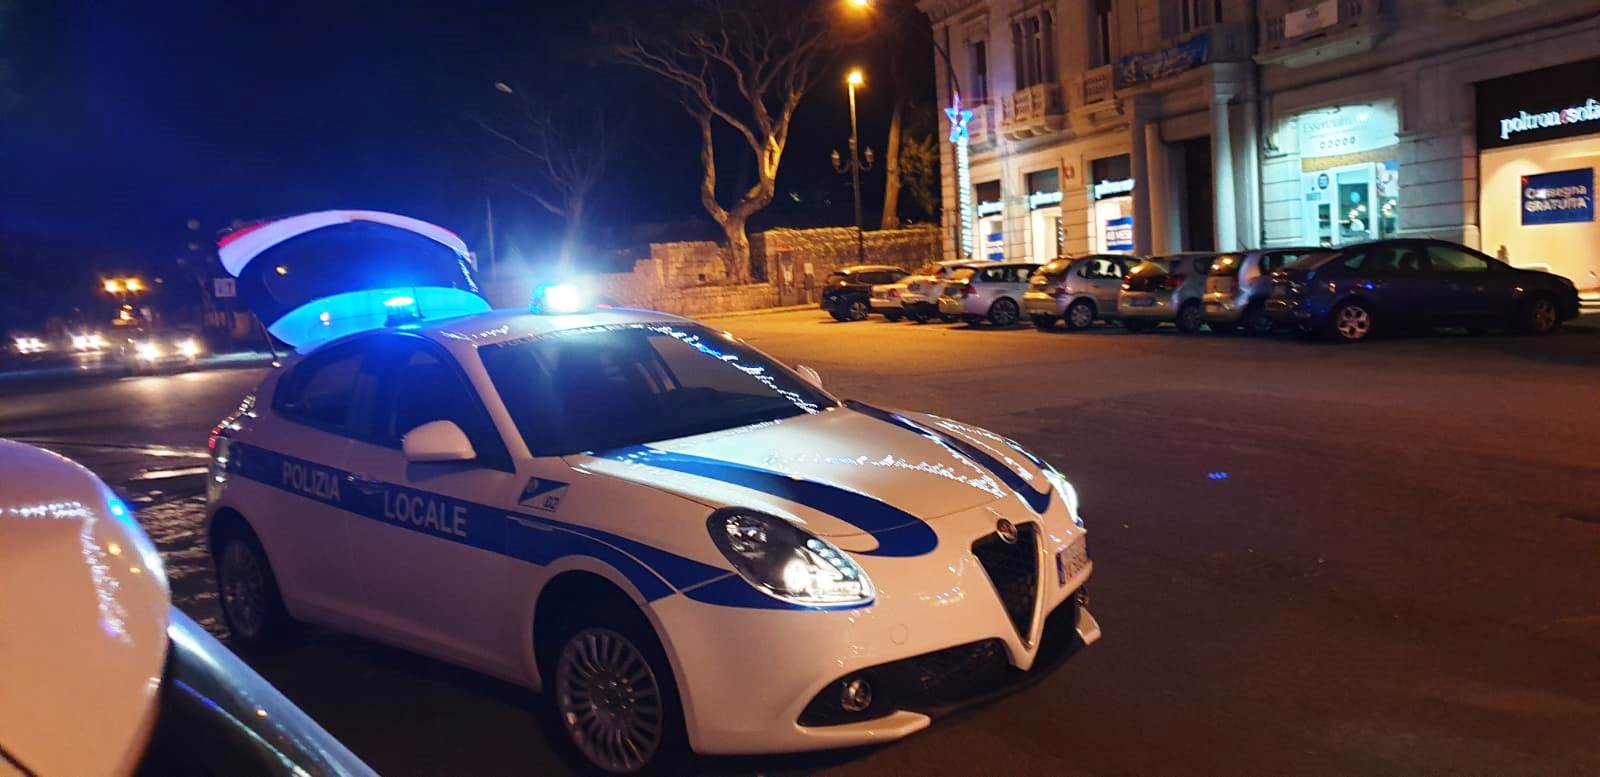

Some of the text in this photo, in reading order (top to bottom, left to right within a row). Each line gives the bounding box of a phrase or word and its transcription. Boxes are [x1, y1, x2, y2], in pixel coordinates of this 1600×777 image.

[1525, 185, 1587, 199] Cnsegna
[282, 461, 468, 537] POLIZIA LOCALE
